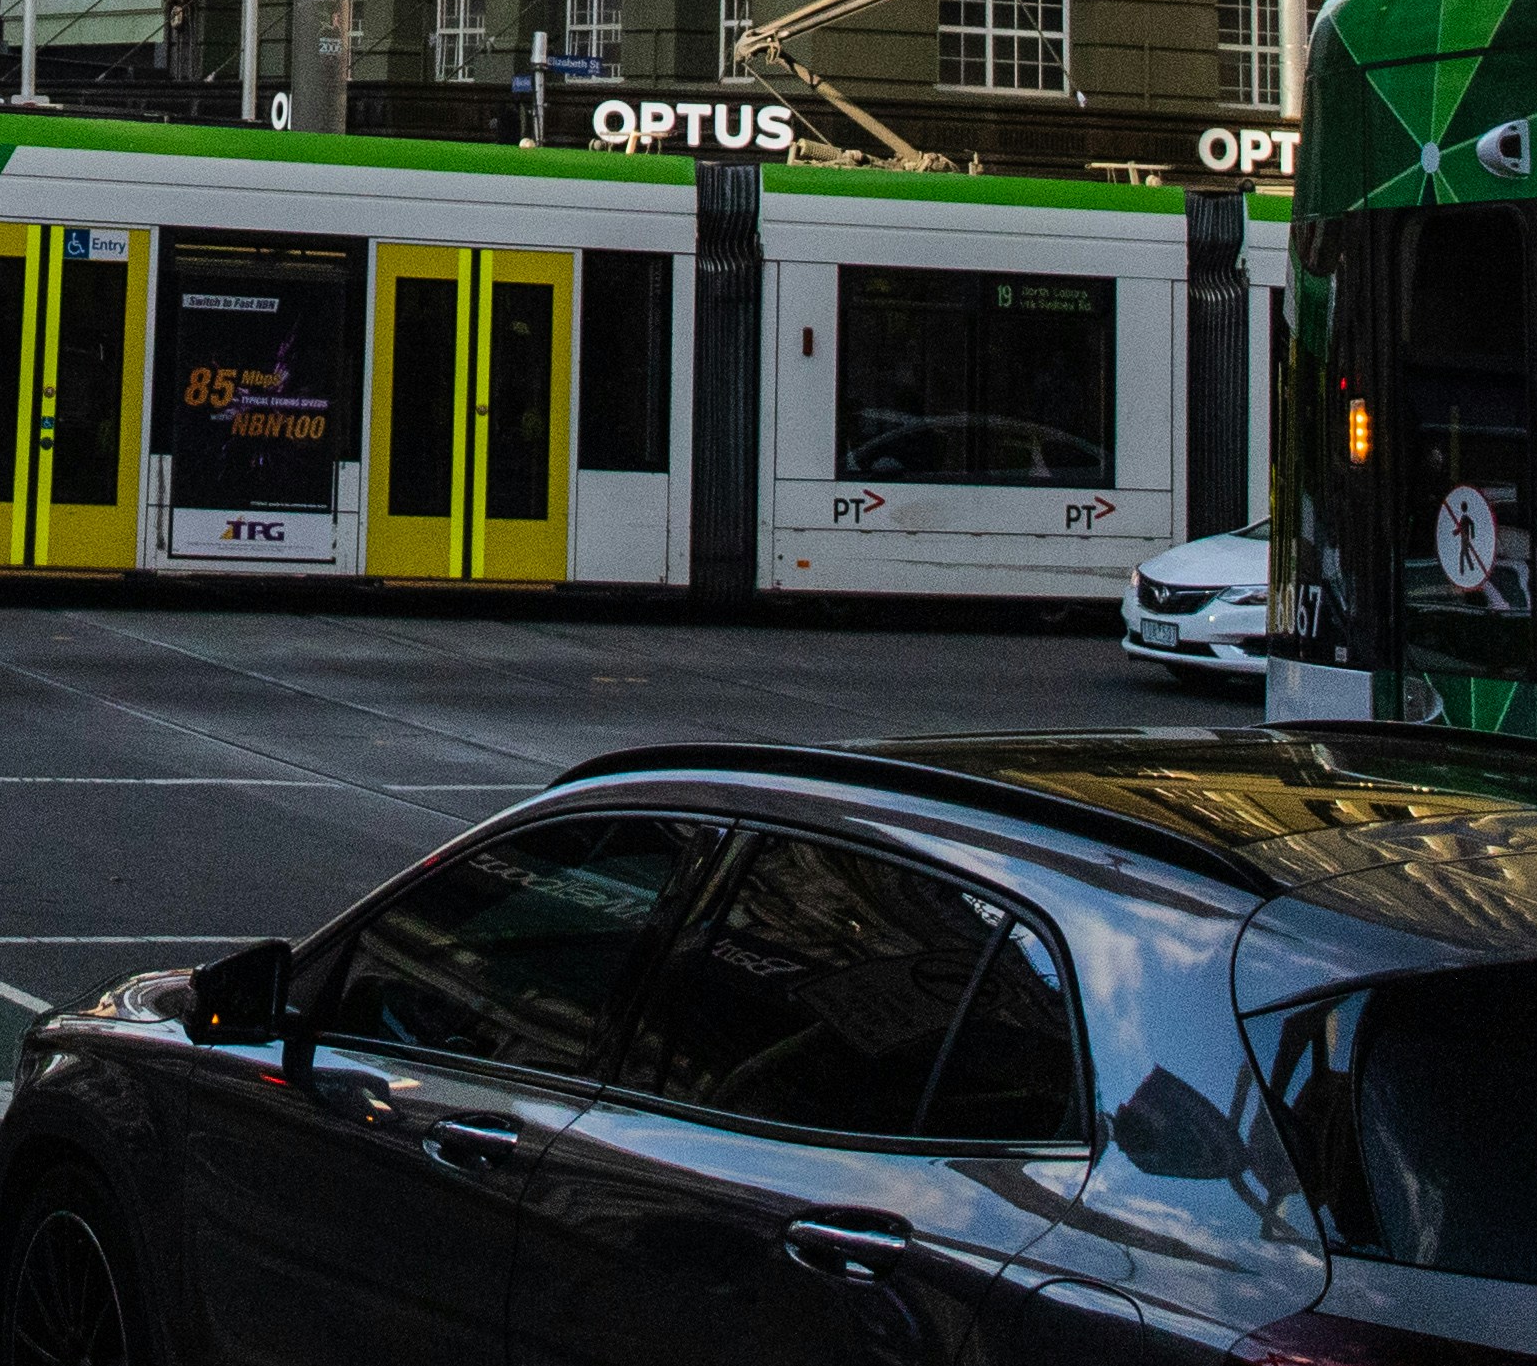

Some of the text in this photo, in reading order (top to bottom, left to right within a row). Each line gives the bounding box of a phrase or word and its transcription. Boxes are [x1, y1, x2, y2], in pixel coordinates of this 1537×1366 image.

[548, 56, 600, 69] Elizabeth St
[593, 99, 795, 150] OPTUS
[91, 237, 126, 254] Entry
[189, 296, 276, 310] Switch to Fast NBN
[998, 285, 1012, 308] 19
[184, 366, 283, 409] 85 Mbps
[241, 395, 269, 406] TYPICAL
[231, 412, 325, 440] NBN100
[227, 520, 285, 542] TPG
